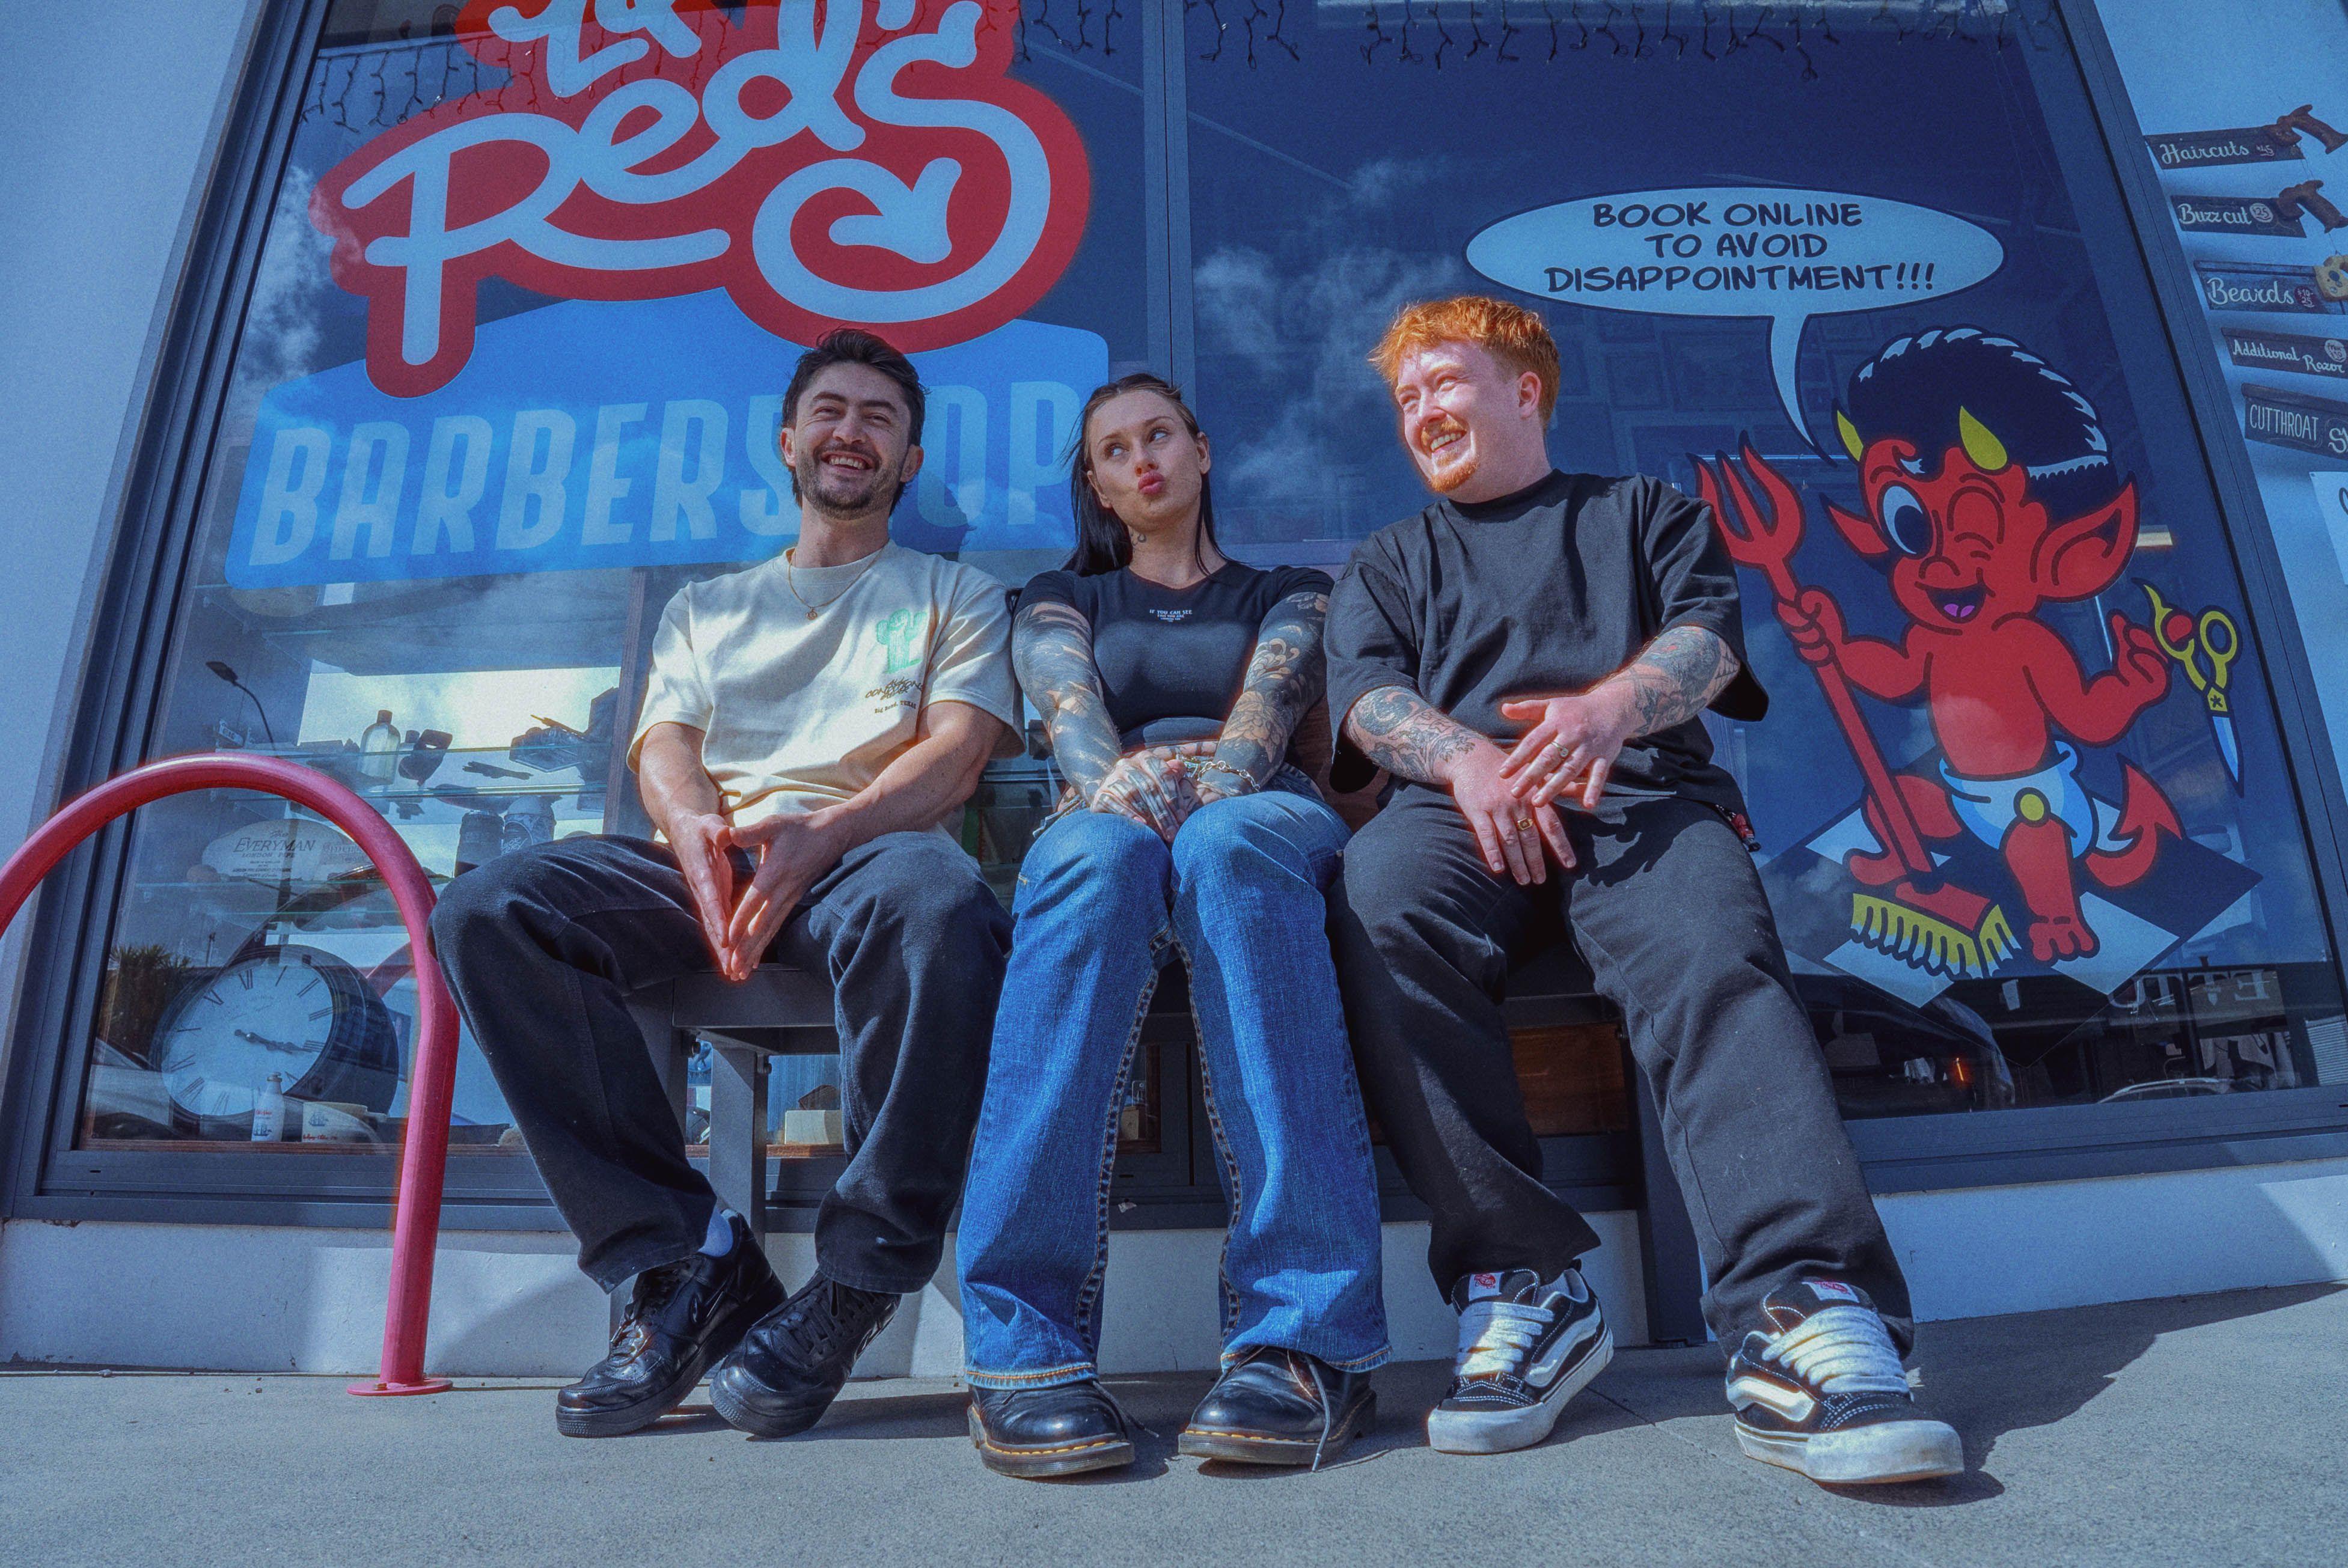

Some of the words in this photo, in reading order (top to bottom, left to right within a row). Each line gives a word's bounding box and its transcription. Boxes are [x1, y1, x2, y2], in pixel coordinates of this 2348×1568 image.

[2159, 141, 2250, 164] Haircuts
[1592, 201, 1711, 228] BOOK
[1723, 203, 1863, 227] ONLINE
[2177, 203, 2222, 225] Buzz
[2222, 207, 2252, 225] cut
[1643, 233, 1702, 258] TO
[1716, 231, 1828, 258] AVOID
[1543, 262, 1935, 293] DISAPPOINTMENT!!!
[2207, 277, 2294, 305] Beards
[2233, 339, 2301, 361] Additional
[2302, 355, 2346, 373] Razor
[2249, 404, 2319, 441] CUTTHROAT
[233, 837, 316, 852] EVERYMAN
